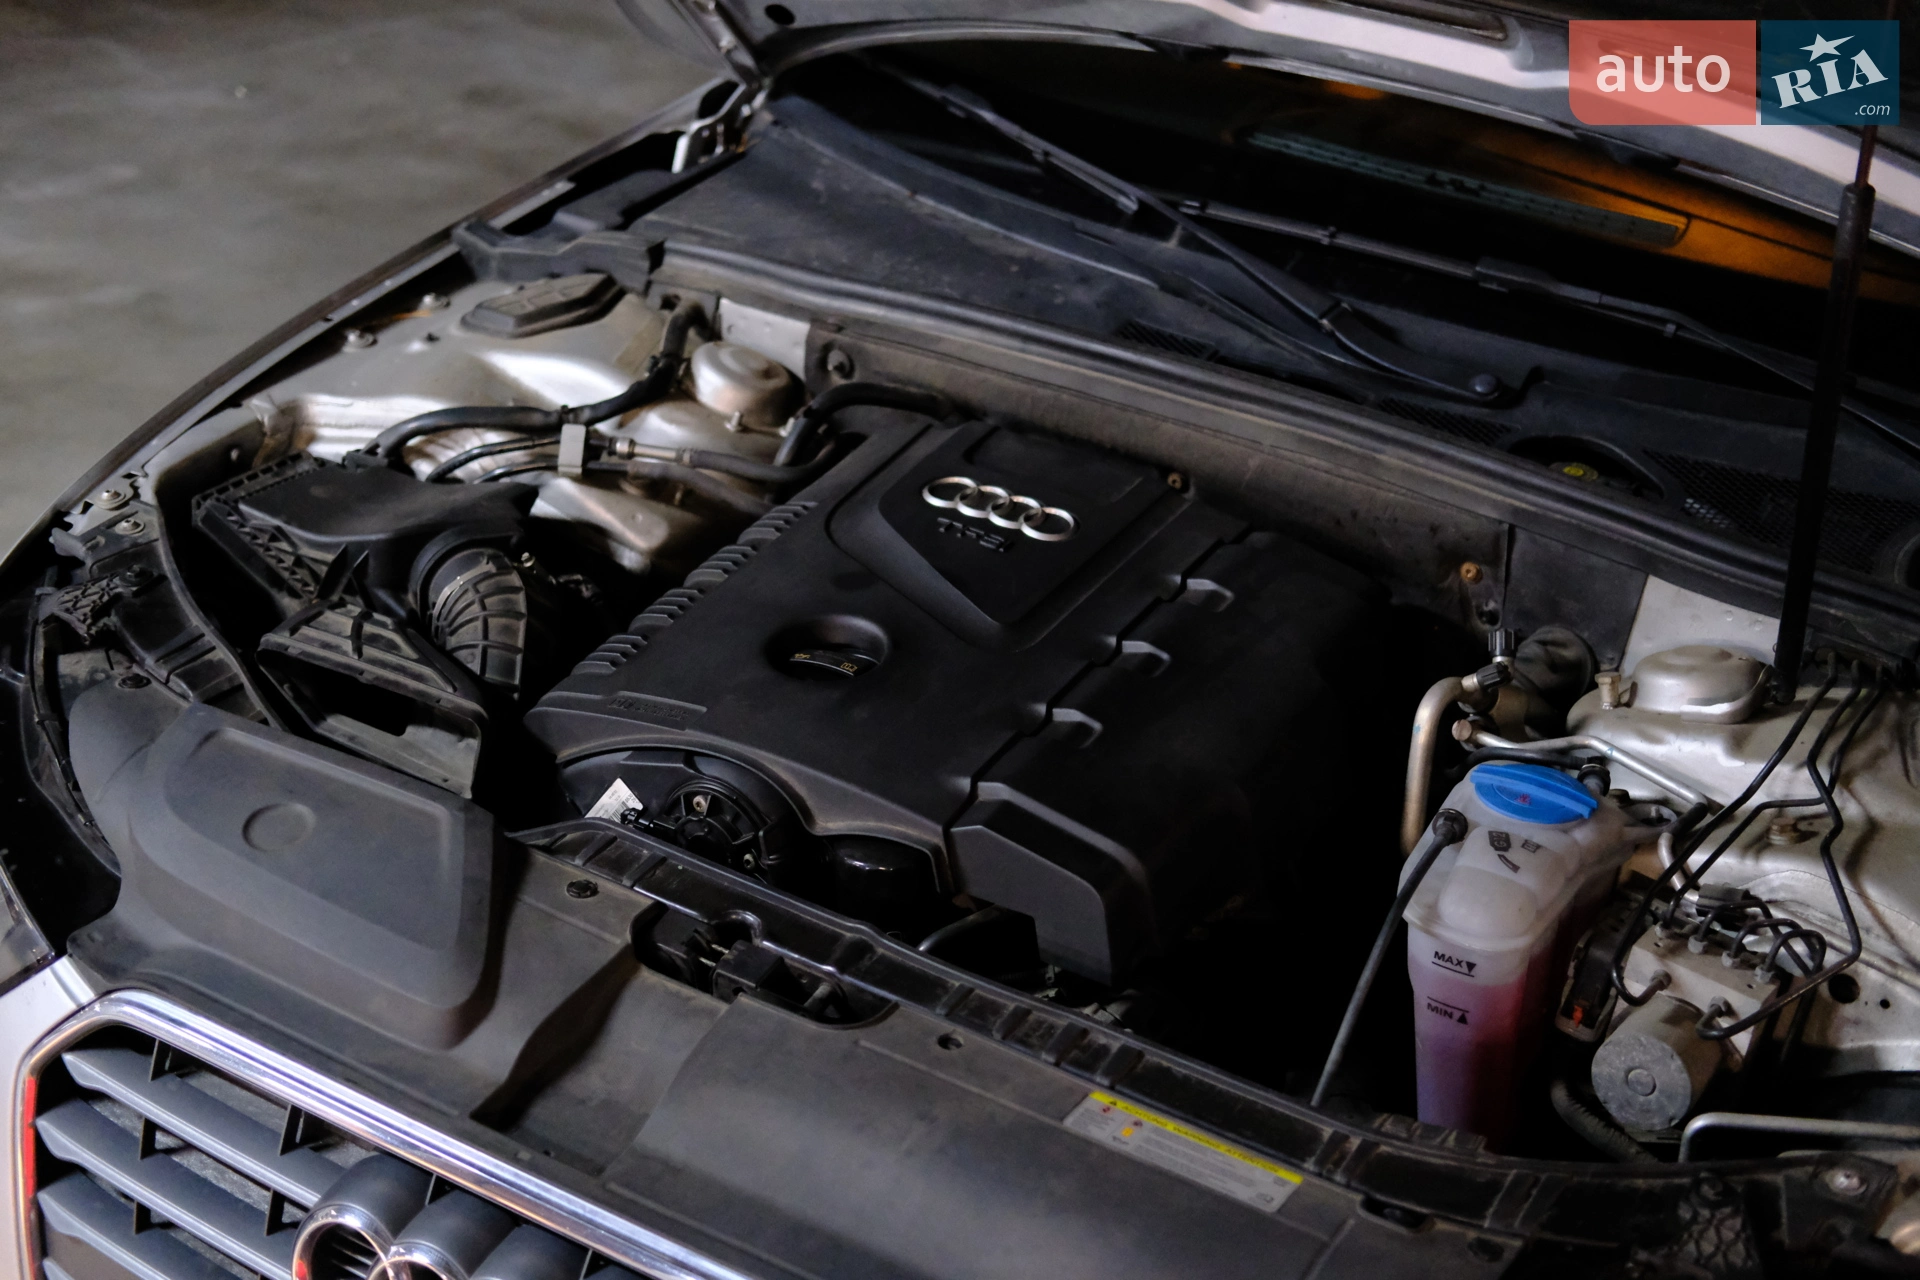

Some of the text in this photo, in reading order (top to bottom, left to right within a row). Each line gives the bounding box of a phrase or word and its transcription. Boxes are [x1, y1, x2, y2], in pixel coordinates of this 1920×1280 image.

[1434, 950, 1464, 969] MAX
[1427, 1002, 1453, 1020] MIN
[1121, 1103, 1168, 1129] ACHTUNG
[1173, 1126, 1221, 1150] WARNING
[1225, 1148, 1280, 1174] ATTENTION
